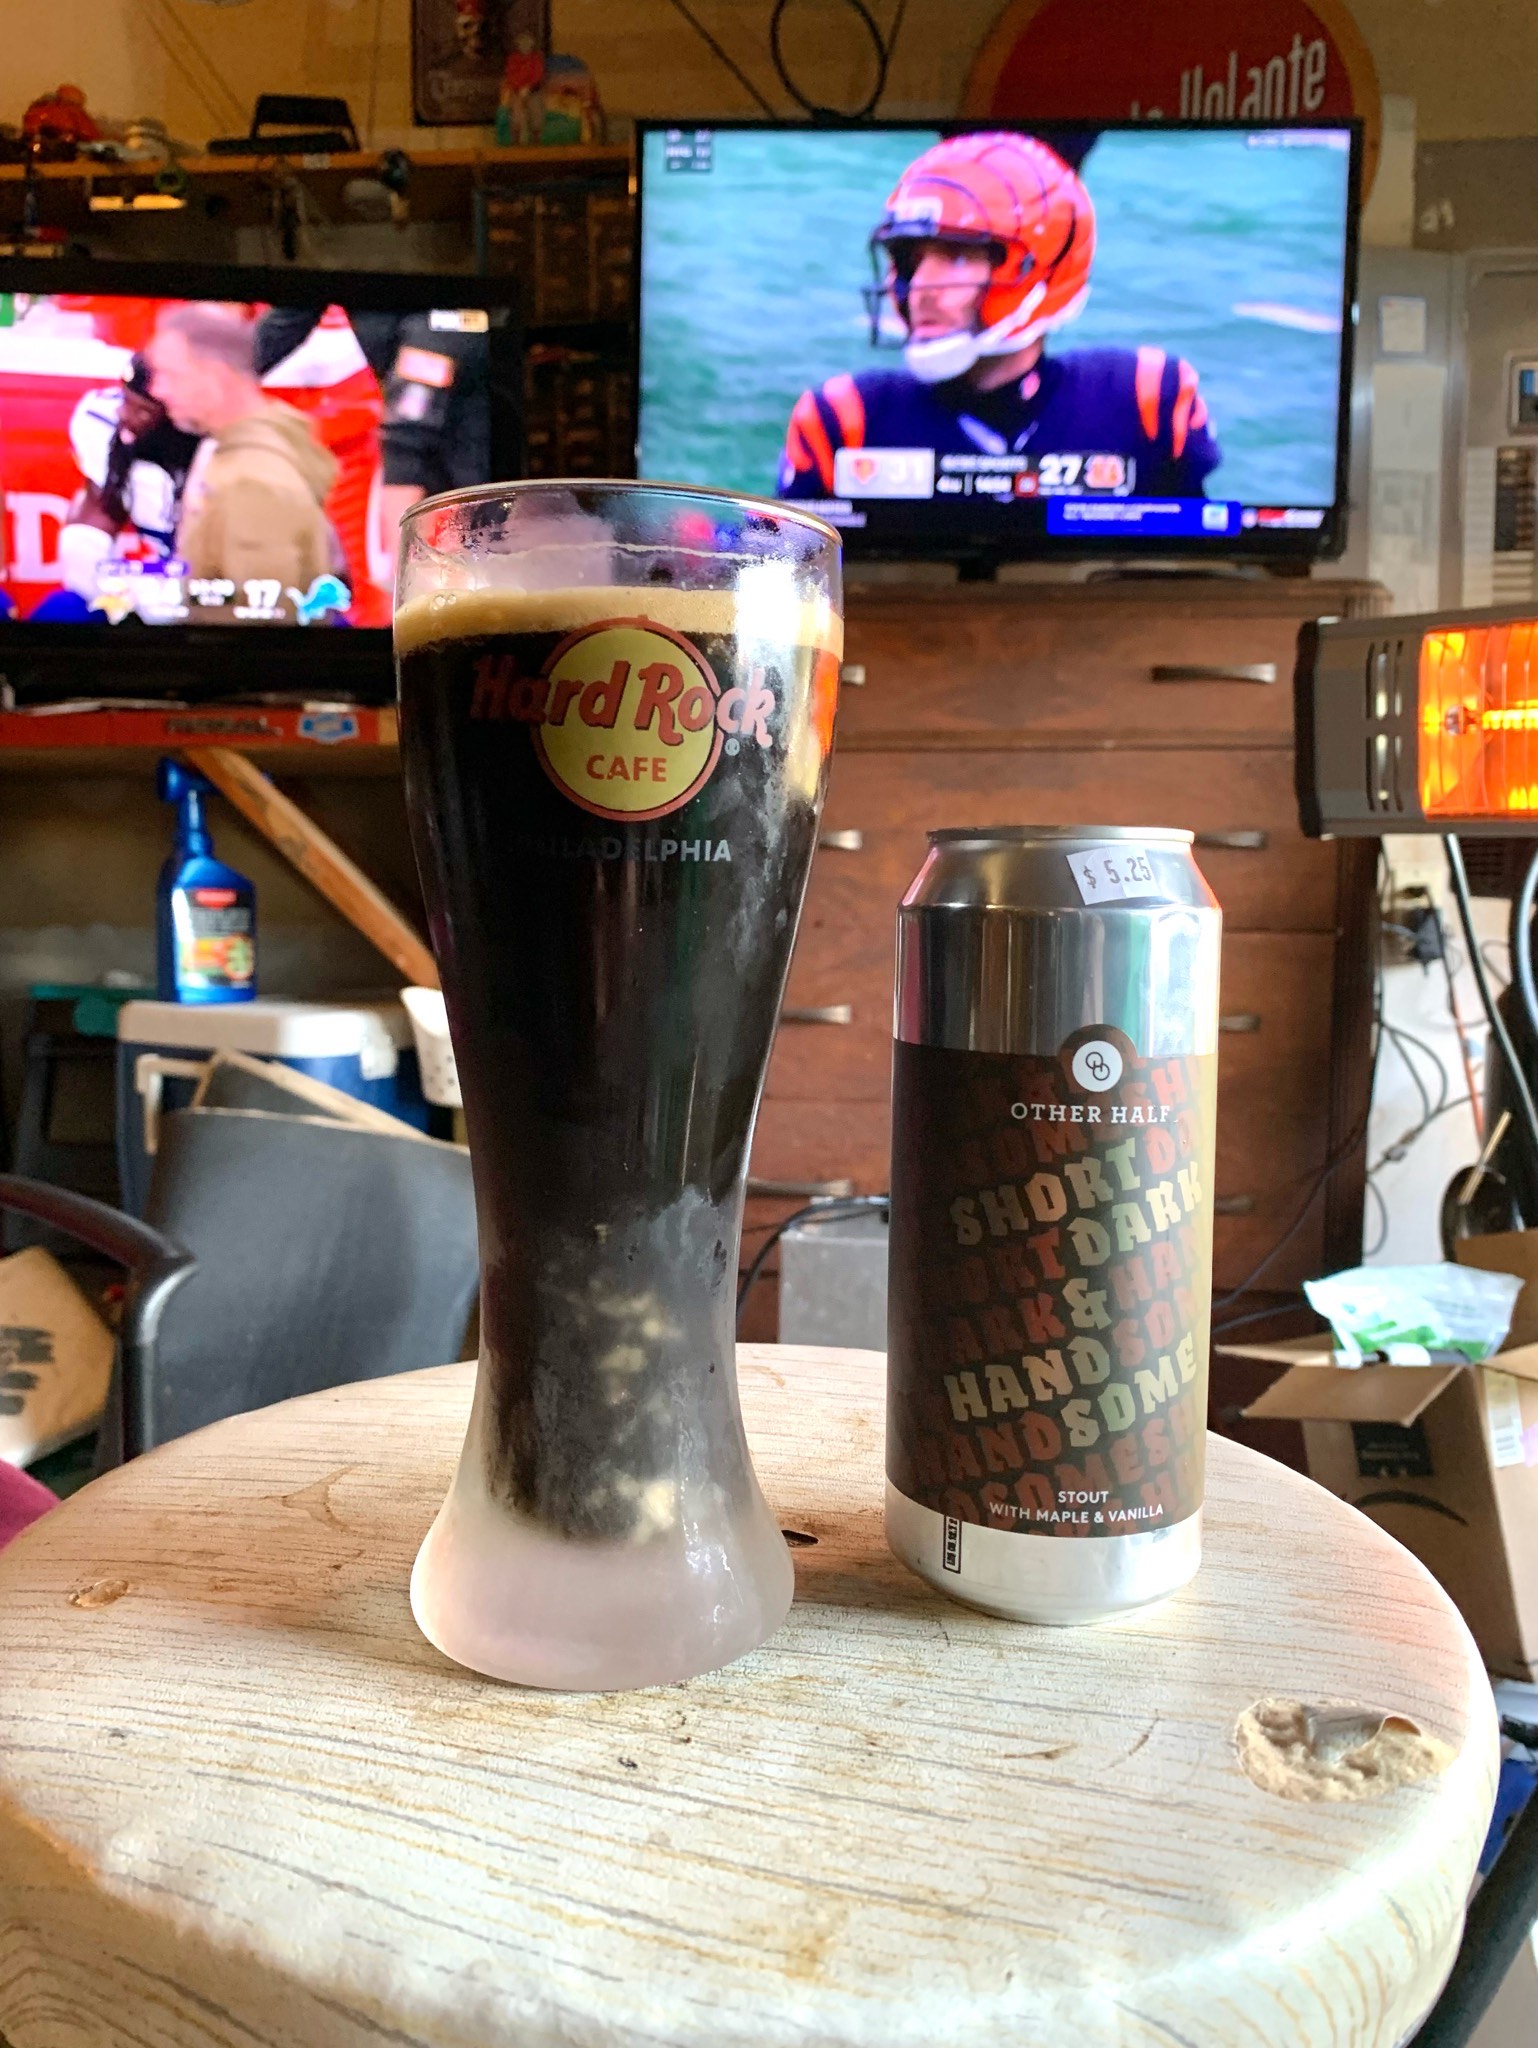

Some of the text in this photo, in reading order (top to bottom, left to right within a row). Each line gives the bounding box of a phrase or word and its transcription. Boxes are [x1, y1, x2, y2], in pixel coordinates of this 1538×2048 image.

[1038, 453, 1083, 486] 27
[470, 654, 776, 748] Hard Rock
[585, 754, 668, 783] CAFE
[1011, 1102, 1171, 1124] OTHER HALF
[950, 1137, 1141, 1246] SHORT
[1067, 1161, 1203, 1267] DARK
[1062, 1277, 1112, 1330] &
[944, 1336, 1111, 1422] HAND
[1061, 1332, 1198, 1447] SOME
[989, 1502, 1164, 1524] WITH MAPLE & VANILLA
[1057, 1490, 1110, 1504] STOUT
